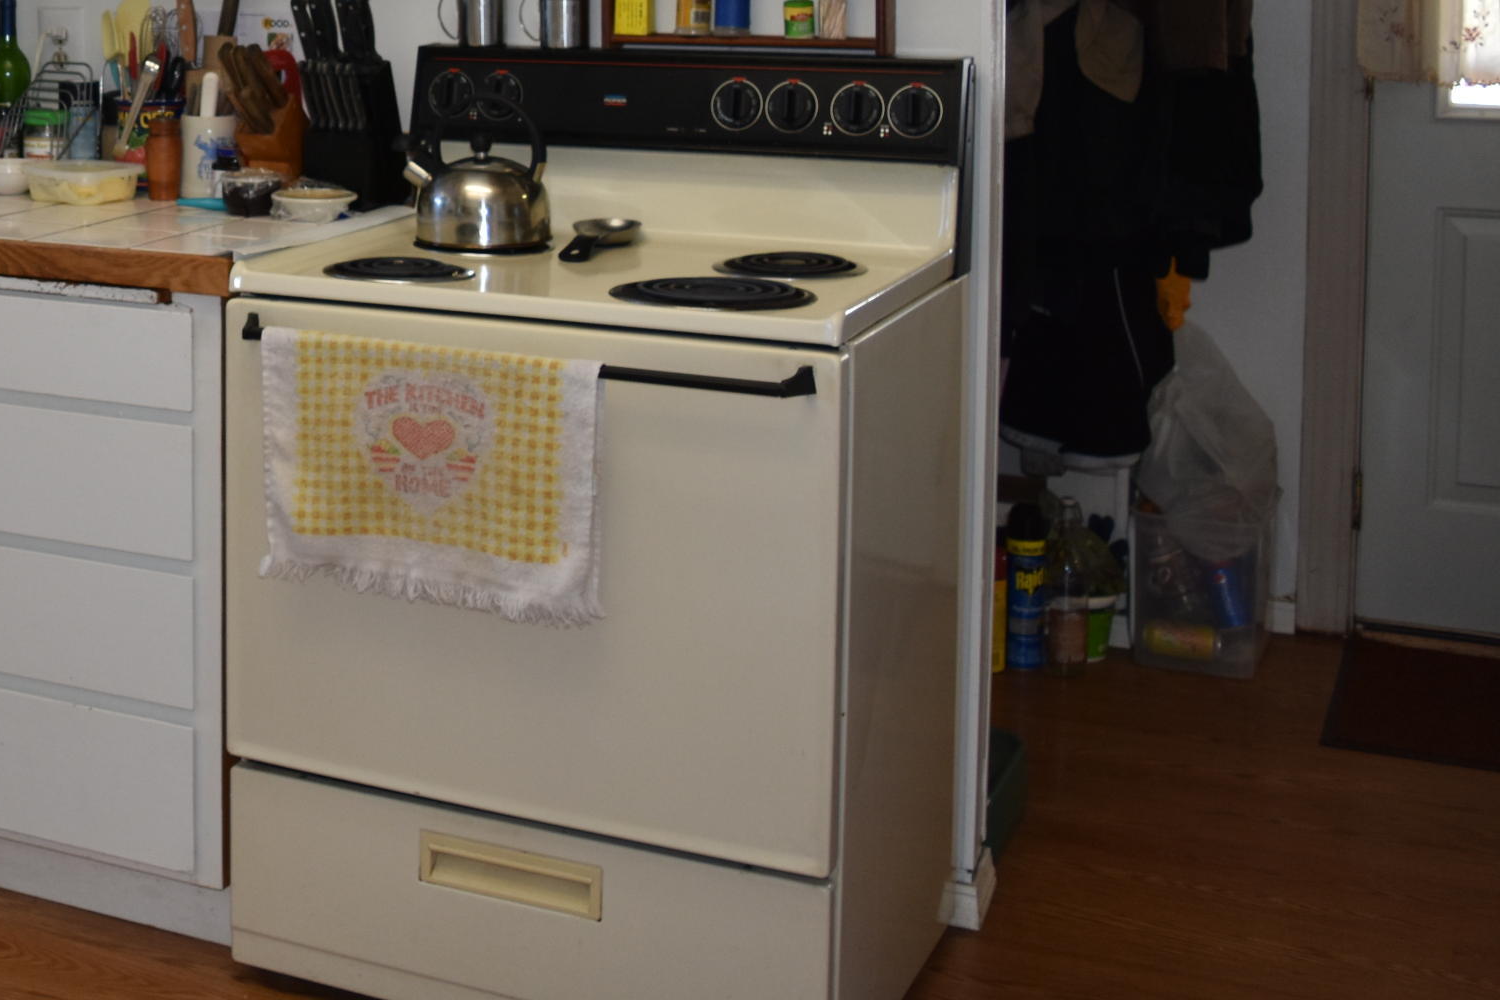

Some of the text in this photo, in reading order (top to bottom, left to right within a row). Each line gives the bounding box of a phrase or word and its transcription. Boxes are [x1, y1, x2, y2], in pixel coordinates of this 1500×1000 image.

[364, 383, 485, 419] THE KITCHEN
[394, 473, 451, 498] HOME
